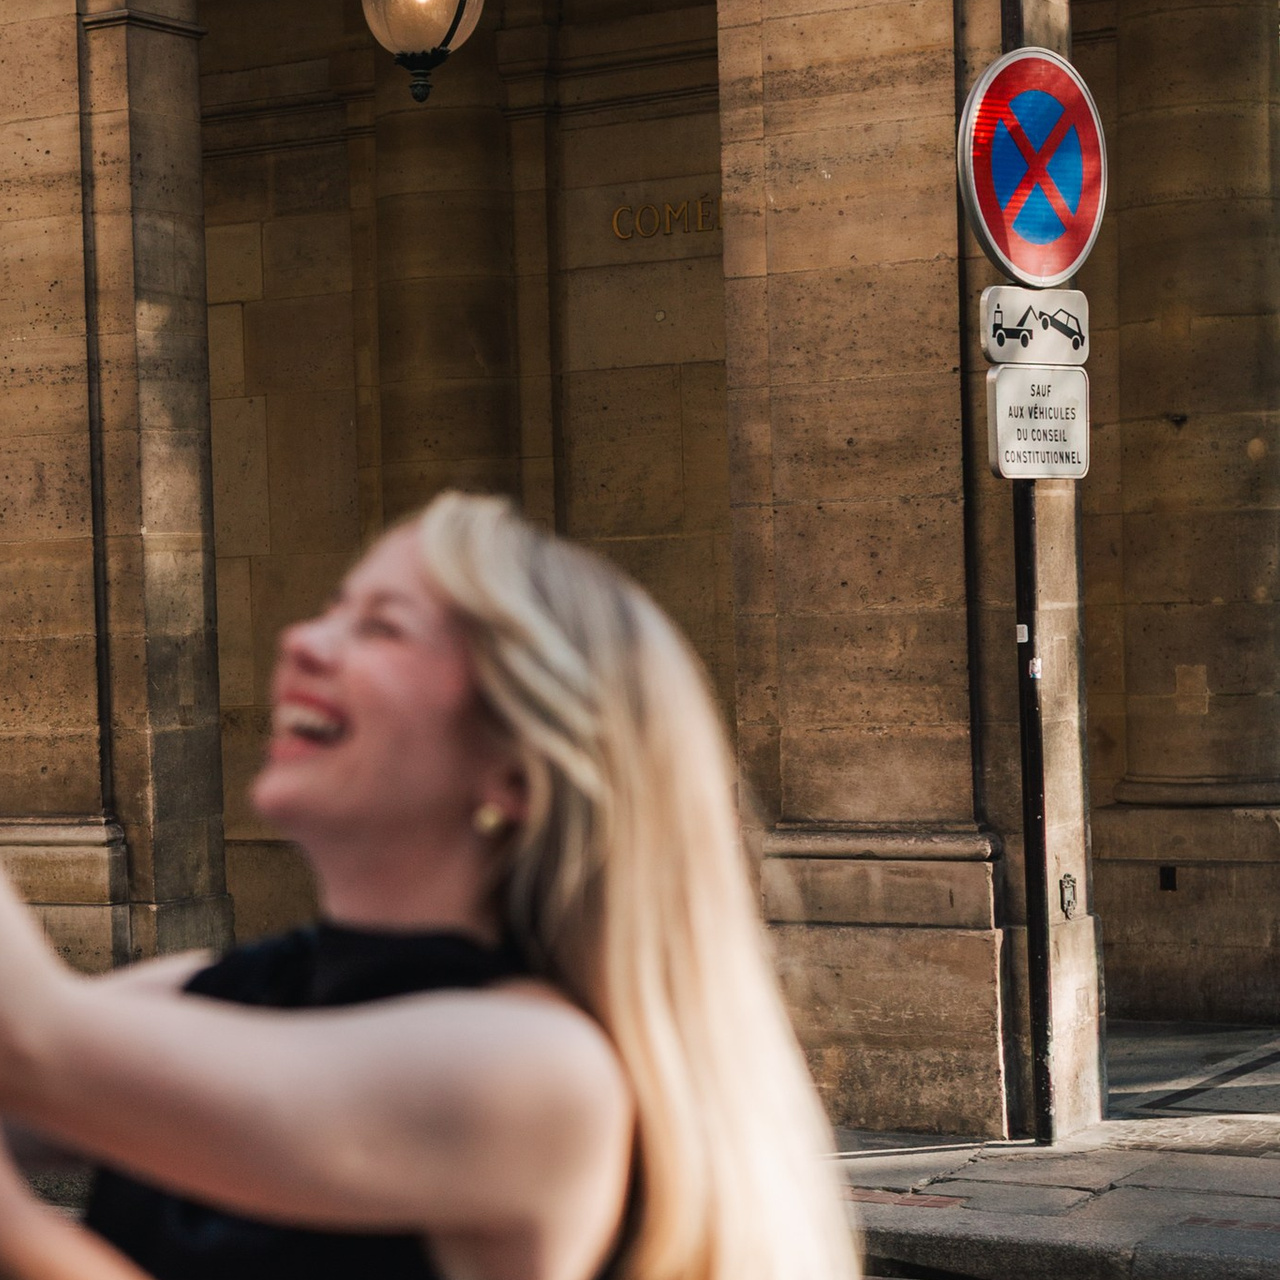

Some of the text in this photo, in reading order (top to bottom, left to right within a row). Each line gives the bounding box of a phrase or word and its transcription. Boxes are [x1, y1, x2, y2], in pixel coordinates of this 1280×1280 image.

[611, 193, 723, 240] COMÉ
[1030, 384, 1052, 397] SAUF
[1008, 403, 1076, 420] AUX VÉHICULES
[1017, 428, 1067, 442] DU CONSEIL
[1004, 450, 1082, 464] CONSTITUTIONNEL
